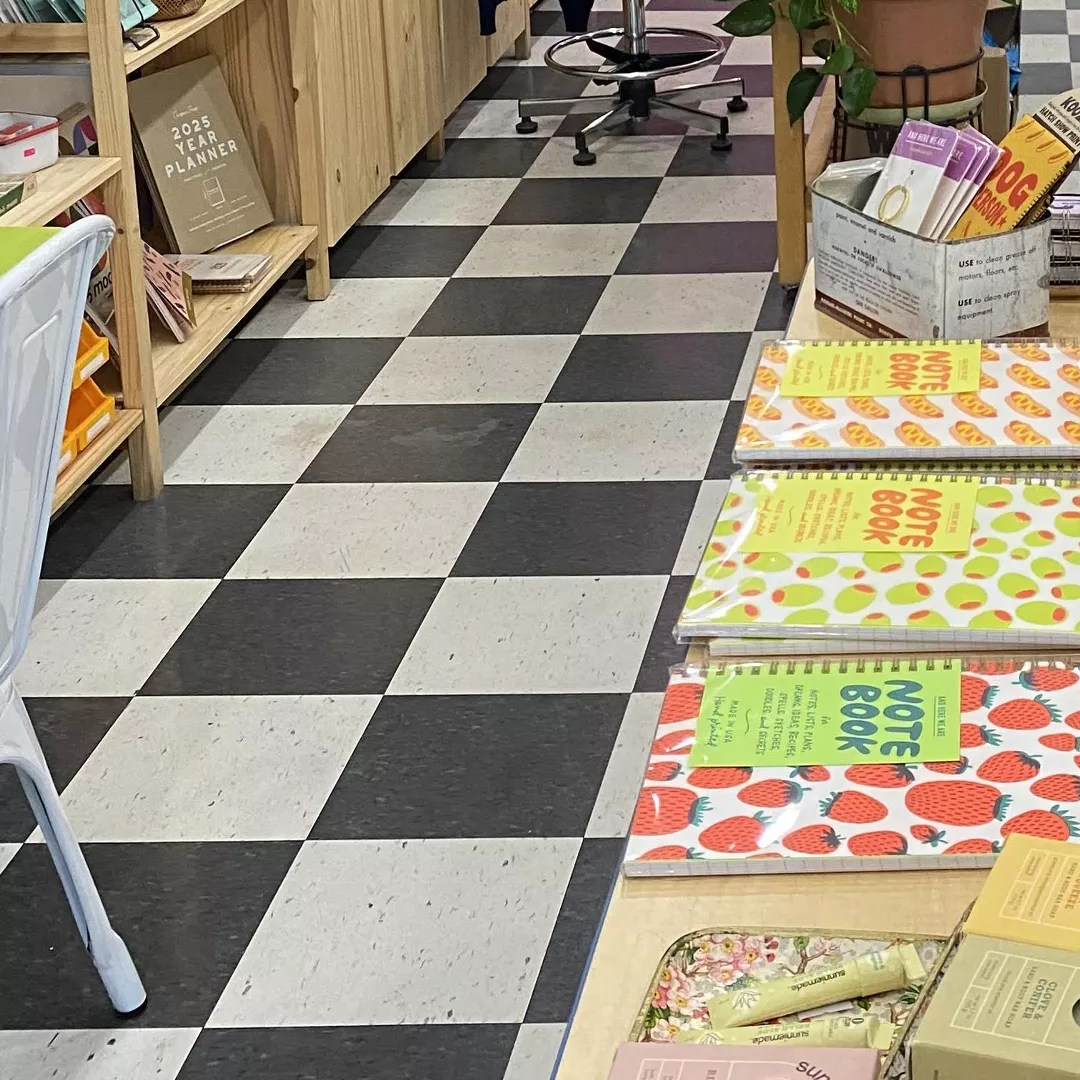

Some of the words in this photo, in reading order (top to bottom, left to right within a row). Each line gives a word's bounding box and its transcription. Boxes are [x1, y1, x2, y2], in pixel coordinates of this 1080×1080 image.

[171, 115, 211, 140] 2025
[1039, 107, 1057, 123] HATCH
[1054, 119, 1071, 134] SHOW
[175, 131, 217, 155] YEAR
[165, 140, 238, 178] PLANNER
[958, 259, 974, 268] USE
[986, 255, 1003, 264] clean
[1005, 249, 1026, 261] grease
[957, 298, 973, 307] USE
[984, 293, 1002, 302] clean
[1003, 289, 1020, 299] spray
[887, 353, 920, 391] BOOK
[919, 350, 953, 392] NOTE
[863, 490, 907, 546] BOOK
[899, 488, 943, 549] NOTE
[709, 696, 726, 716] Hand
[728, 700, 738, 718] MADE
[937, 706, 946, 718] HERE
[938, 696, 946, 705] AND
[759, 716, 771, 729] and
[835, 684, 882, 755] BOOK
[880, 679, 924, 757] NOTE
[705, 718, 724, 747] printed
[724, 730, 734, 743] USA
[937, 727, 946, 737] ARE
[791, 970, 846, 992] sunniemade
[1022, 978, 1049, 1020] CONIFER
[1042, 981, 1058, 1011] CLOVE
[752, 1031, 810, 1046] sunniemade
